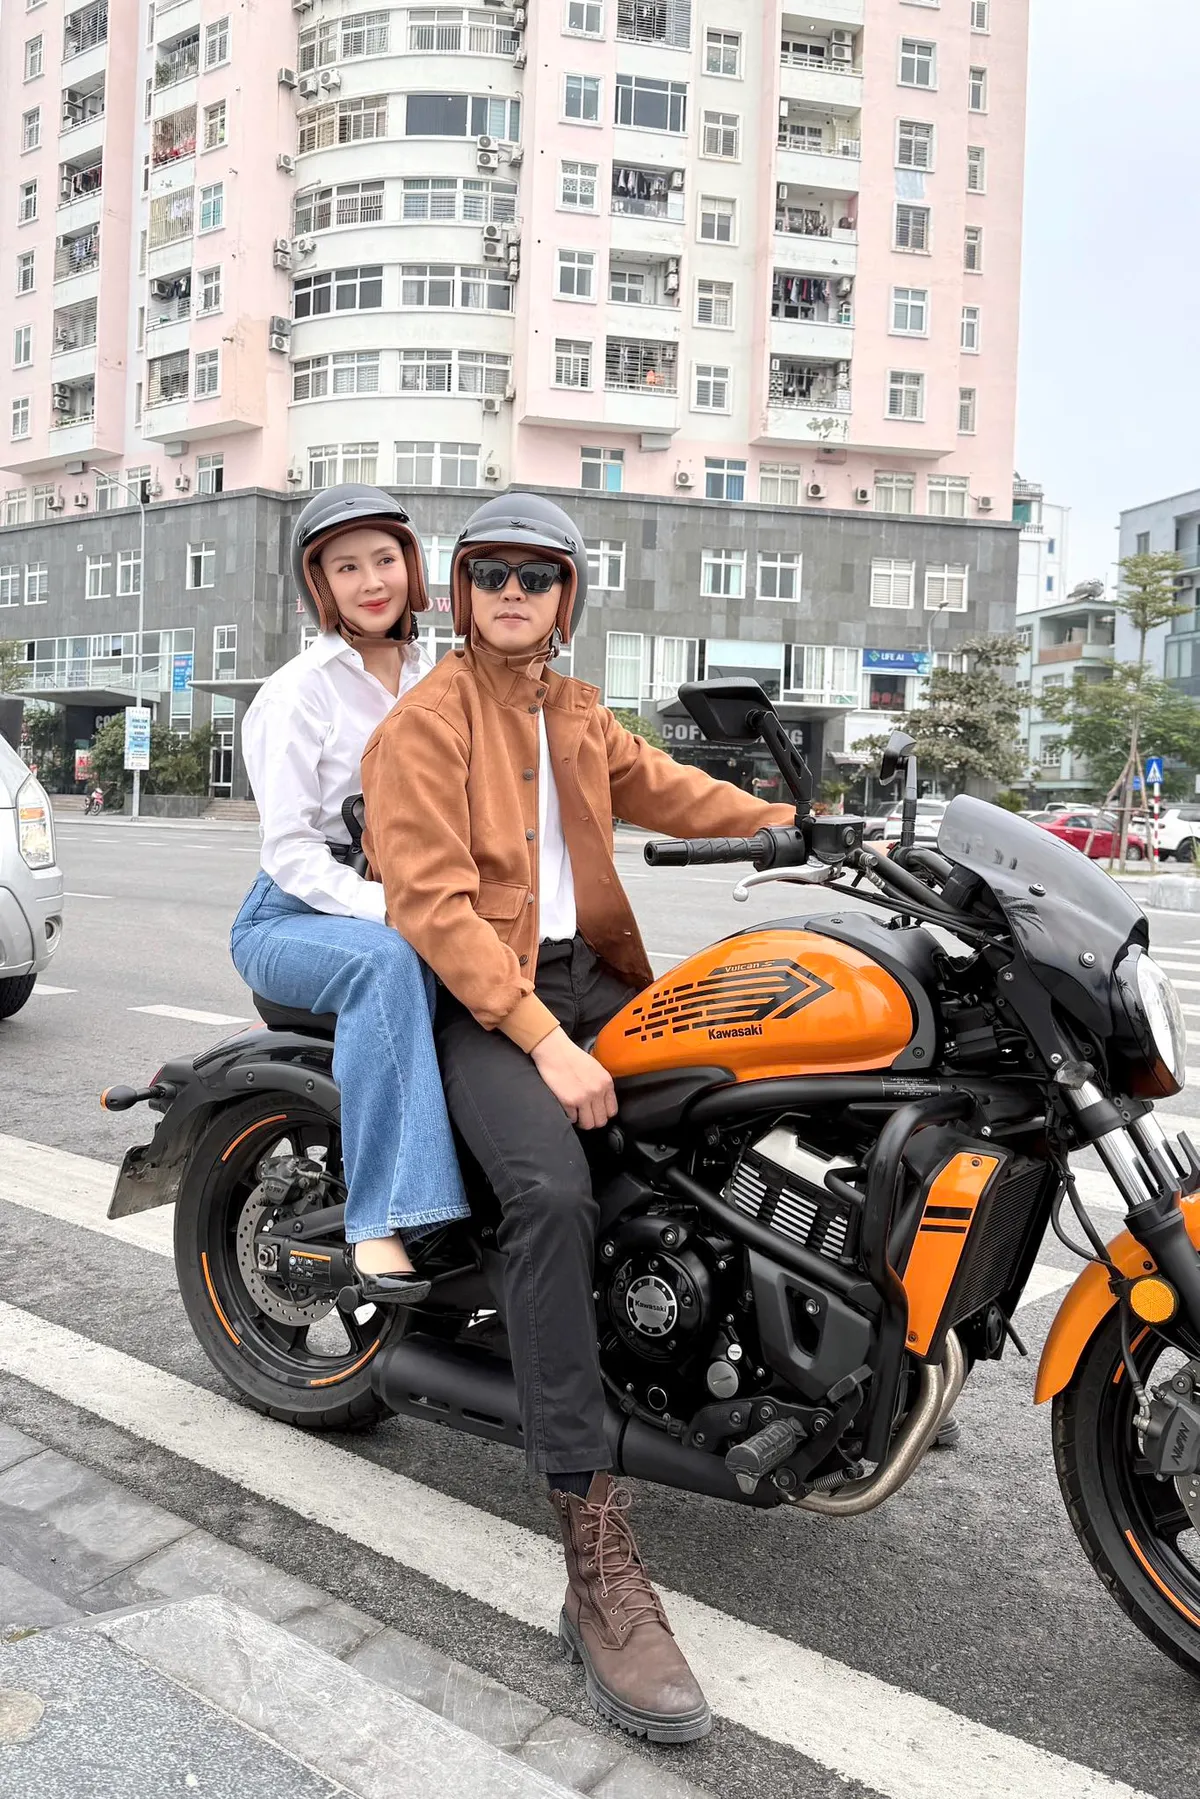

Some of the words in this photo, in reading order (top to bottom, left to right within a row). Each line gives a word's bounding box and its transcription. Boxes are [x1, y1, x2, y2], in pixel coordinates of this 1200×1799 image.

[881, 652, 895, 661] LIFE
[895, 653, 905, 661] AI
[724, 962, 761, 973] Vulcan
[708, 1024, 763, 1040] Kawasaki
[635, 1300, 667, 1313] Kawasaki
